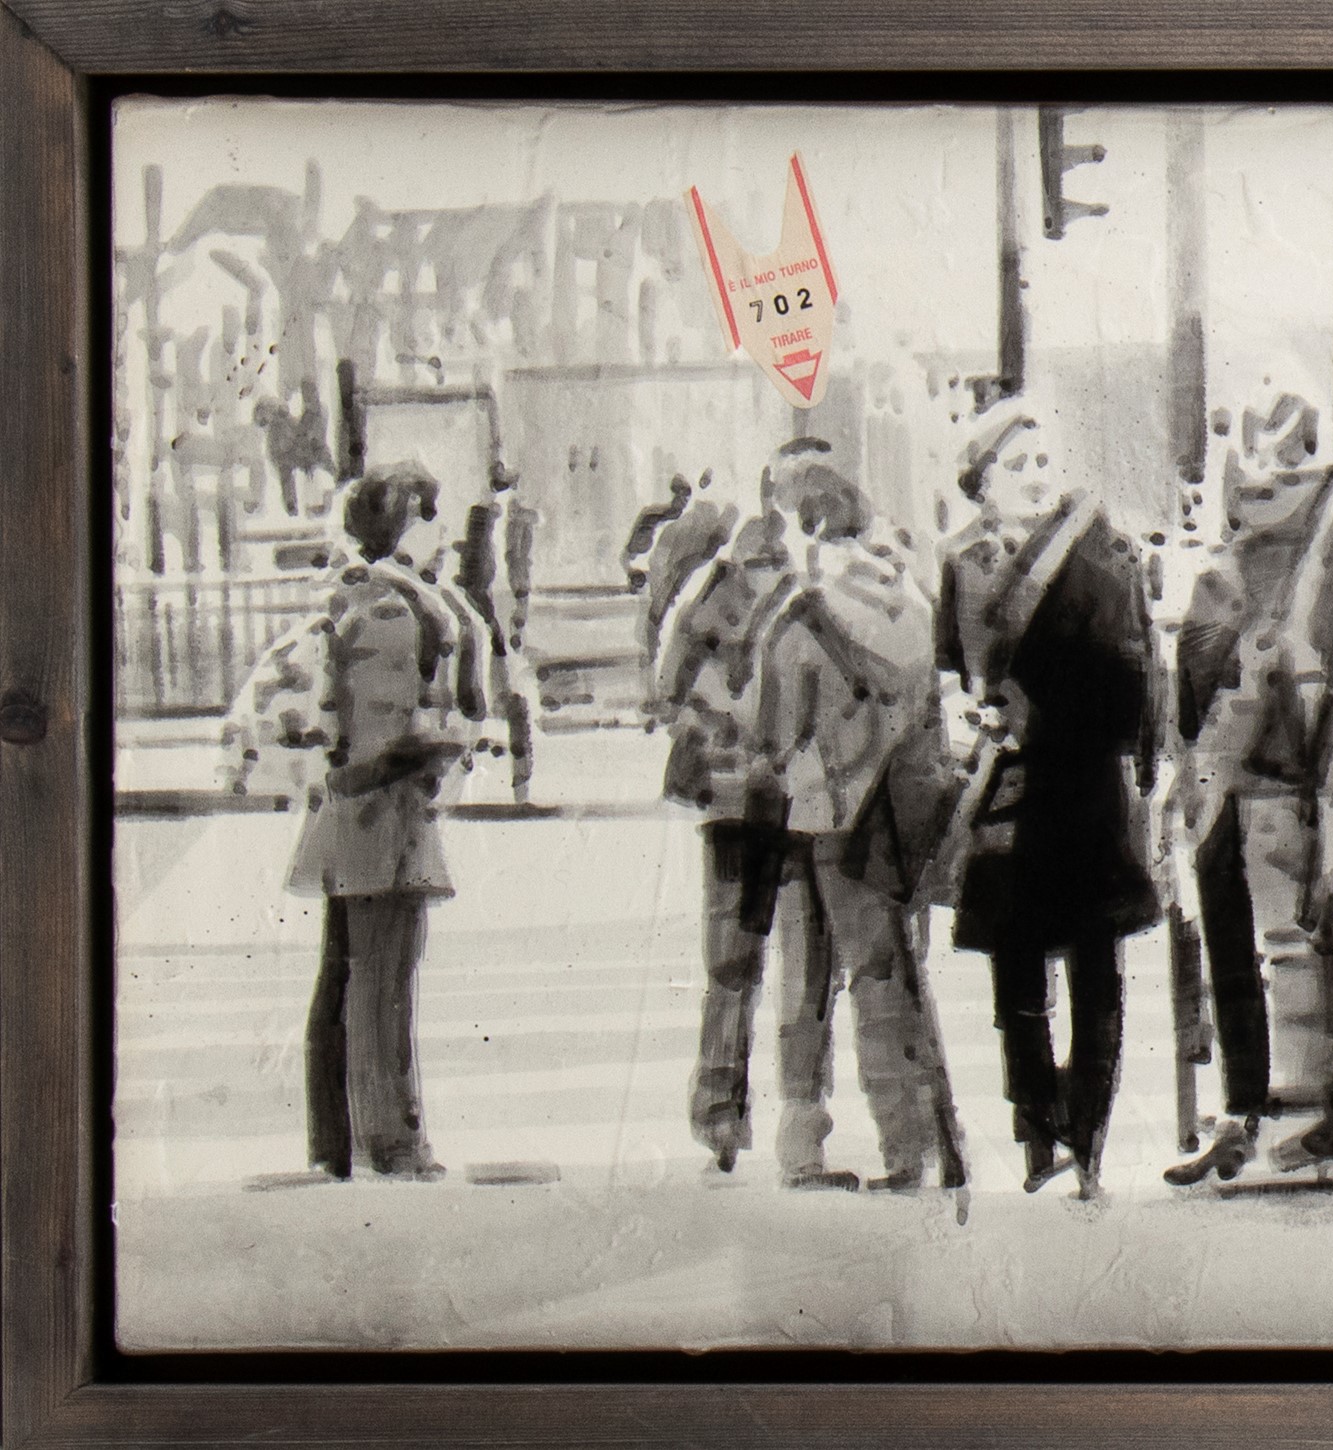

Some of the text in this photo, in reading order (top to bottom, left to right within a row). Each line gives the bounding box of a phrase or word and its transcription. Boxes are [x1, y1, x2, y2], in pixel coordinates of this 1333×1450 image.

[740, 277, 751, 290] IL
[754, 270, 776, 285] MIO
[779, 258, 818, 278] TURNO
[770, 328, 813, 349] TIRARE
